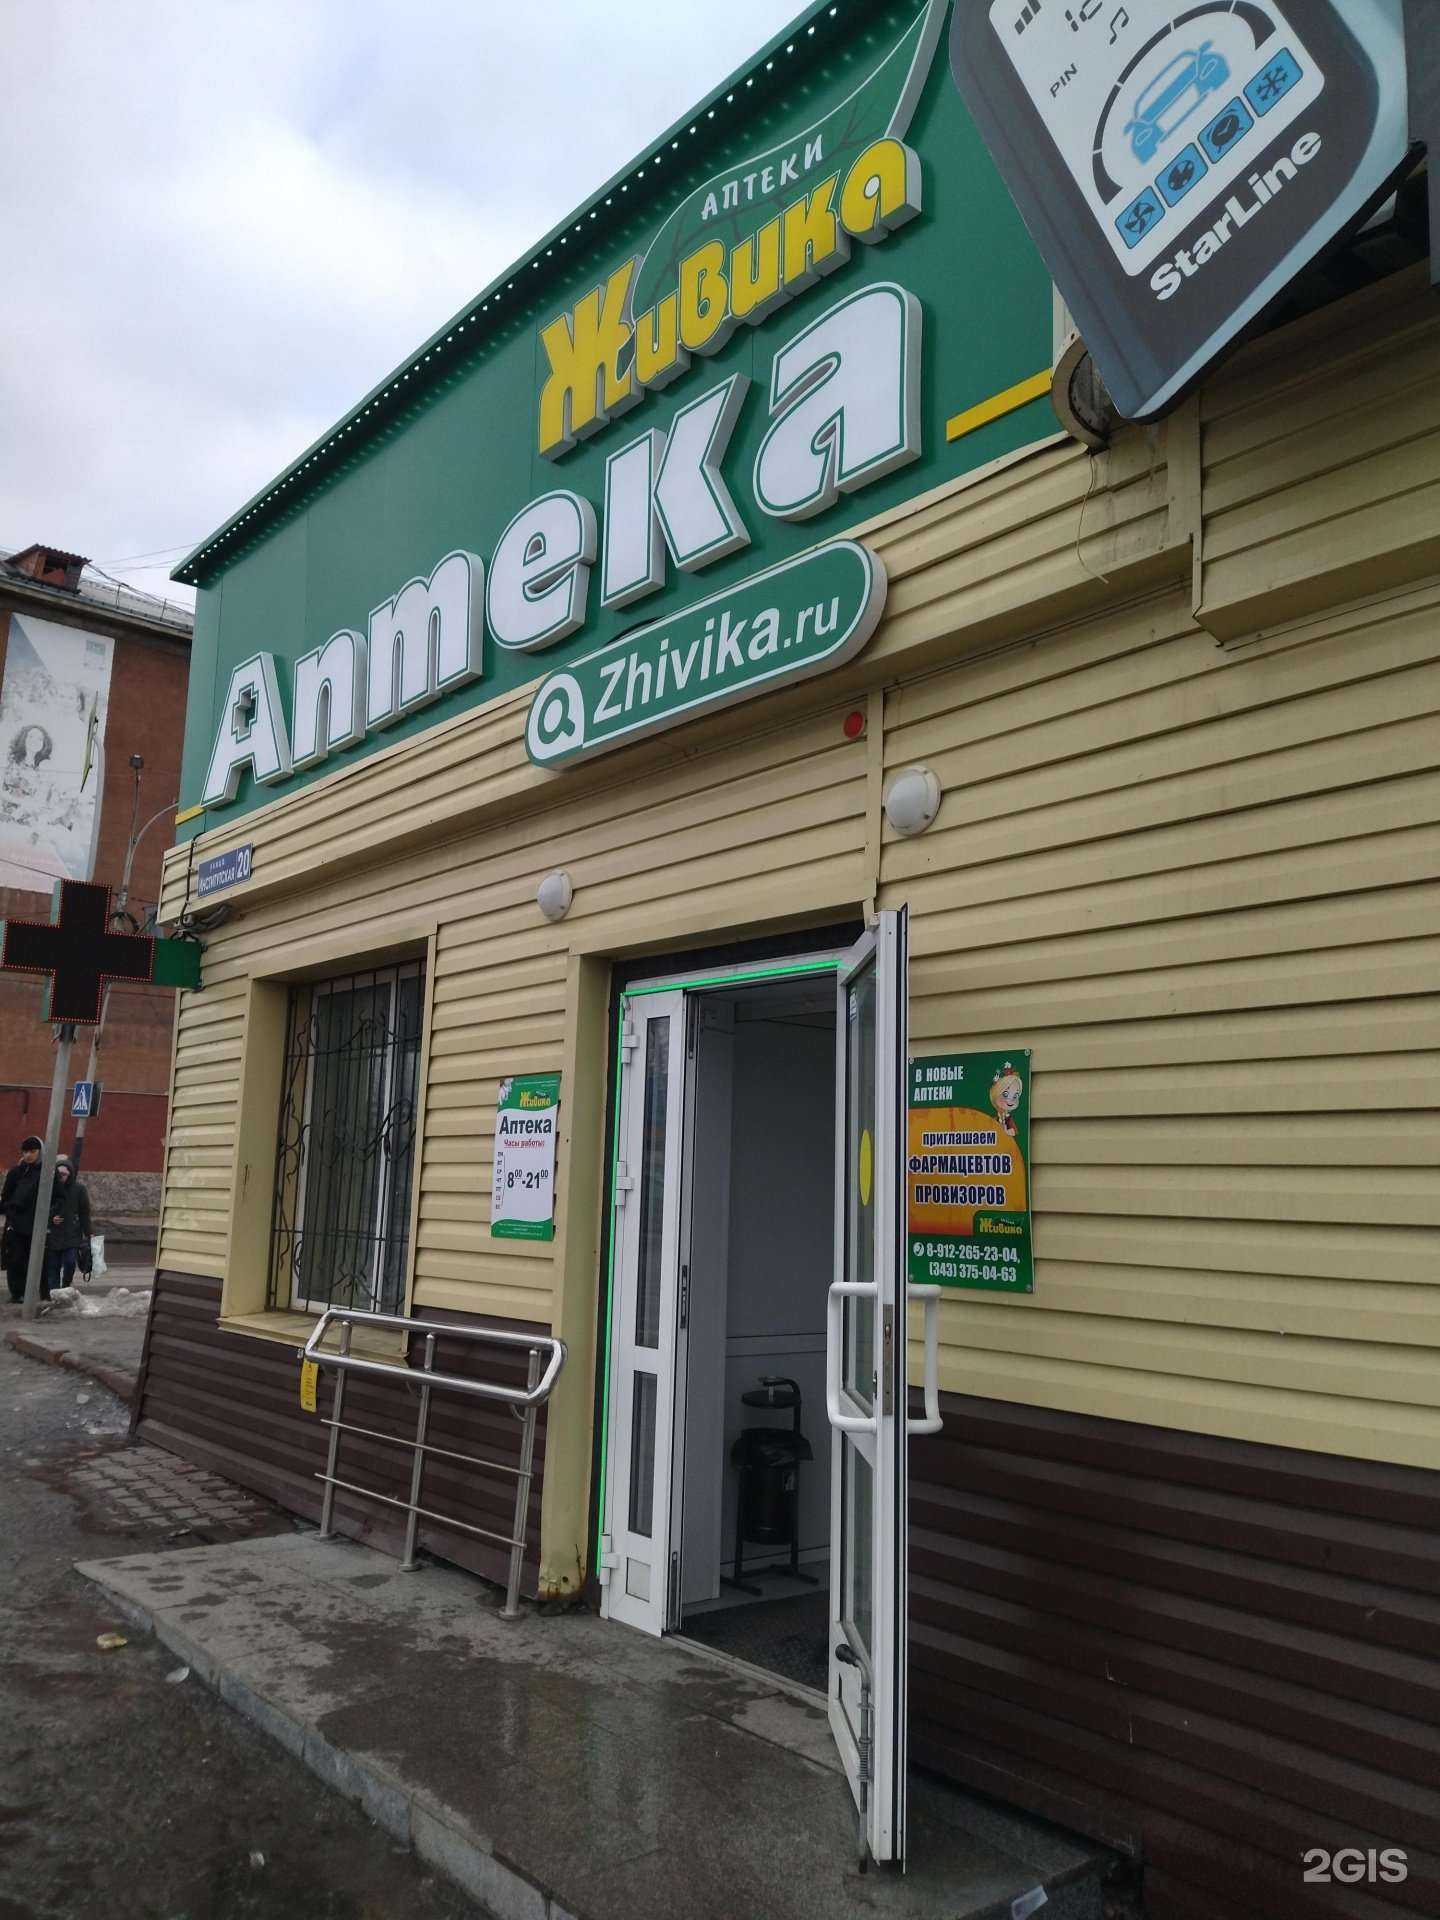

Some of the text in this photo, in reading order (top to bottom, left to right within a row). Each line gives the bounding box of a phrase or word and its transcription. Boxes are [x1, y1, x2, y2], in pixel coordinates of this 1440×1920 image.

[1049, 62, 1078, 98] PIN
[700, 133, 824, 221] АПТЕКИ
[1149, 130, 1323, 301] StarLine
[538, 136, 918, 460] Живика
[201, 282, 920, 809] Аптека
[593, 596, 840, 724] Zhivika.ru
[237, 849, 250, 878] 20
[915, 1065, 964, 1083] В НОВЫЕ
[913, 1085, 953, 1102] АПТЕКИ
[499, 1115, 552, 1135] Аптека
[504, 1140, 520, 1148] Часы
[922, 1131, 997, 1147] приглашаем
[908, 1154, 1011, 1176] ФАРМАЦЕВТОВ
[915, 1185, 1006, 1205] ПРОВИЗОРОВ
[979, 1217, 1023, 1235] Живика
[929, 1261, 1017, 1283] (343) 375-04-63
